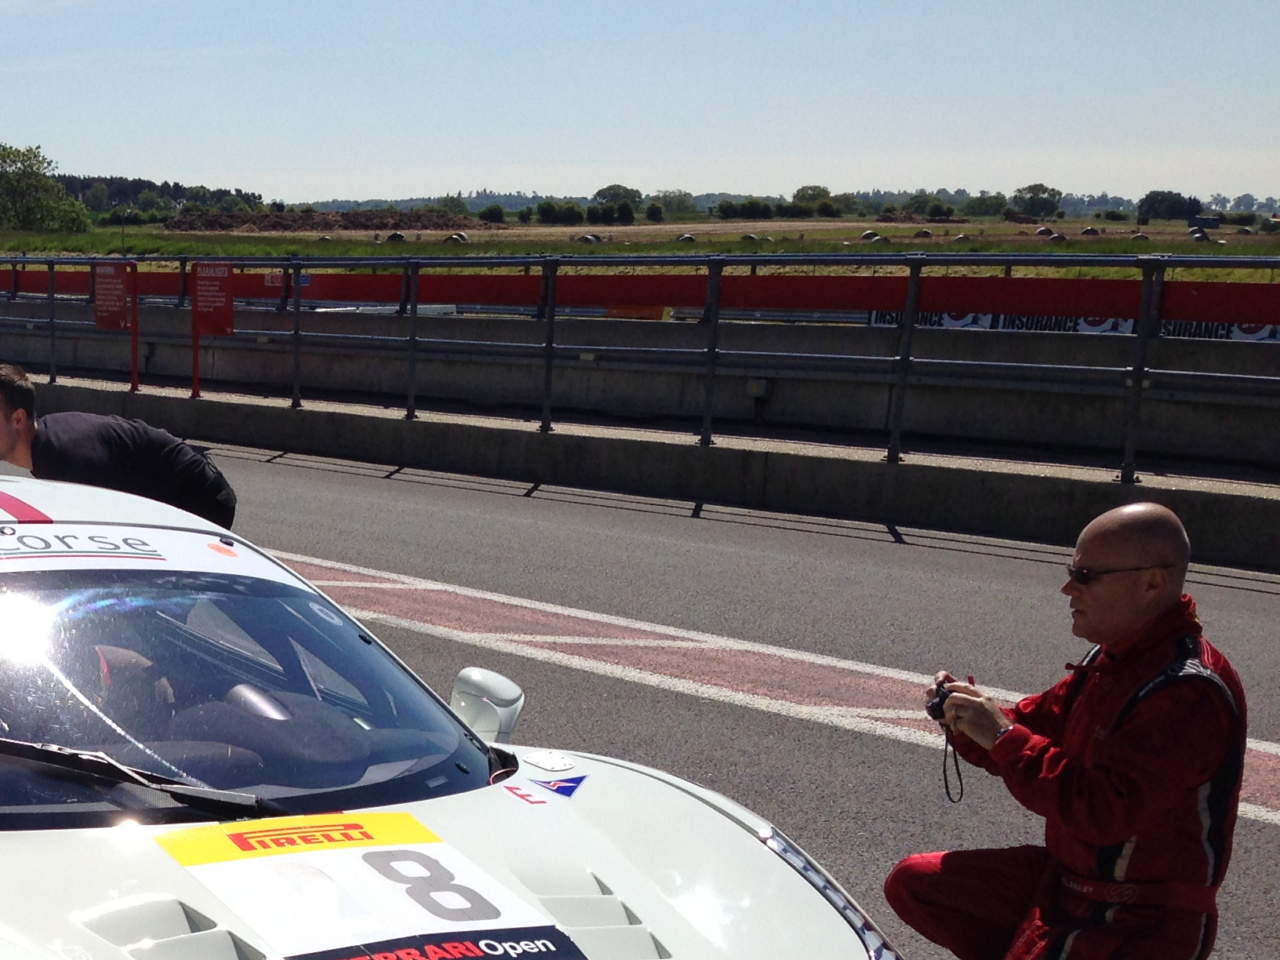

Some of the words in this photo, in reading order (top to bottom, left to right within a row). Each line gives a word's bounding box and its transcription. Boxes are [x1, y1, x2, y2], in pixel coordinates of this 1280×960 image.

[874, 310, 944, 327] INSUANCE
[1002, 315, 1080, 333] INSURANCE
[228, 823, 374, 851] PIRELLI
